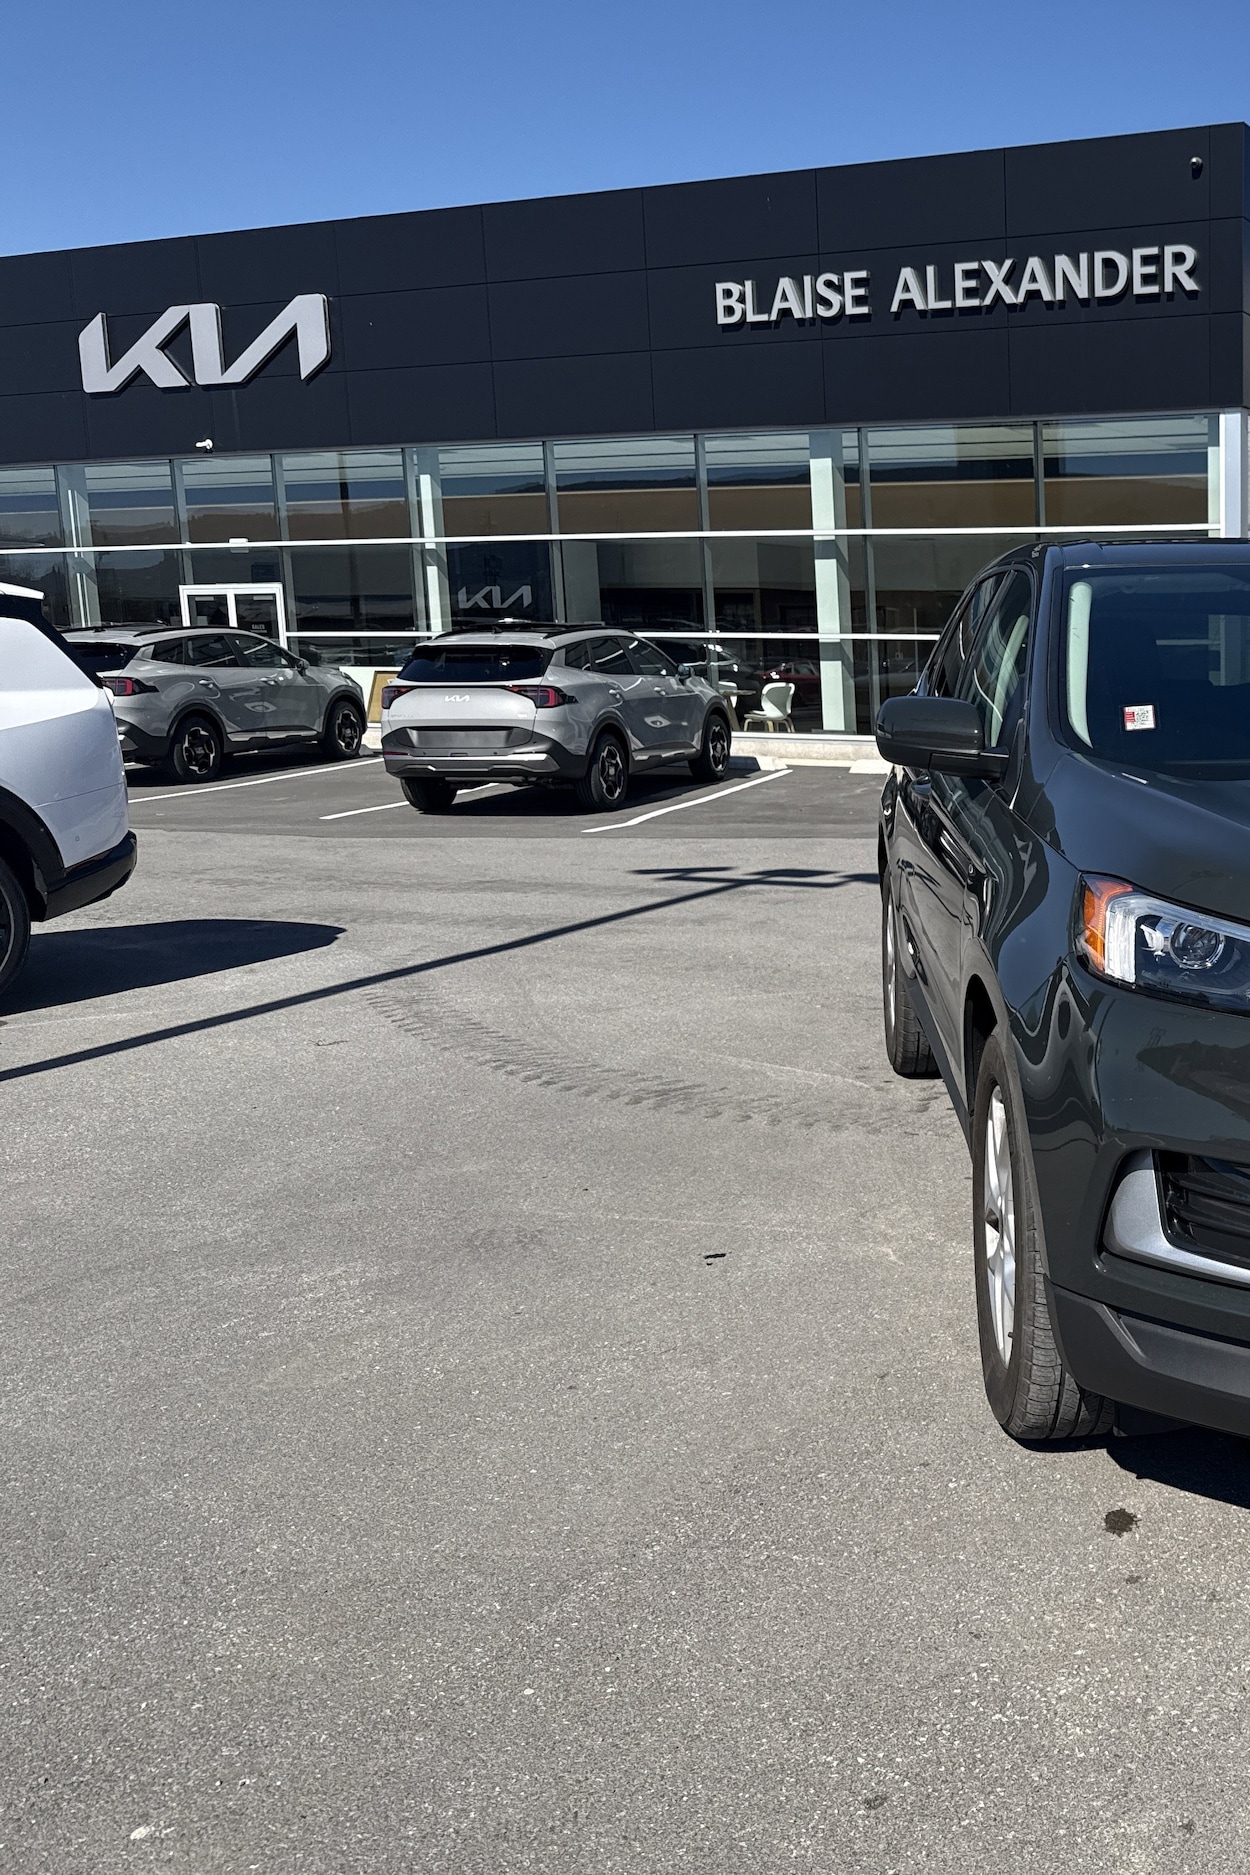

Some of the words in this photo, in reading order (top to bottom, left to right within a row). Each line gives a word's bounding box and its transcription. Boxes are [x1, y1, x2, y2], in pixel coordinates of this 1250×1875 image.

[714, 269, 871, 326] BLAISE
[890, 244, 1200, 314] ALEXANDER
[78, 293, 331, 395] KIA
[457, 585, 532, 609] KIA
